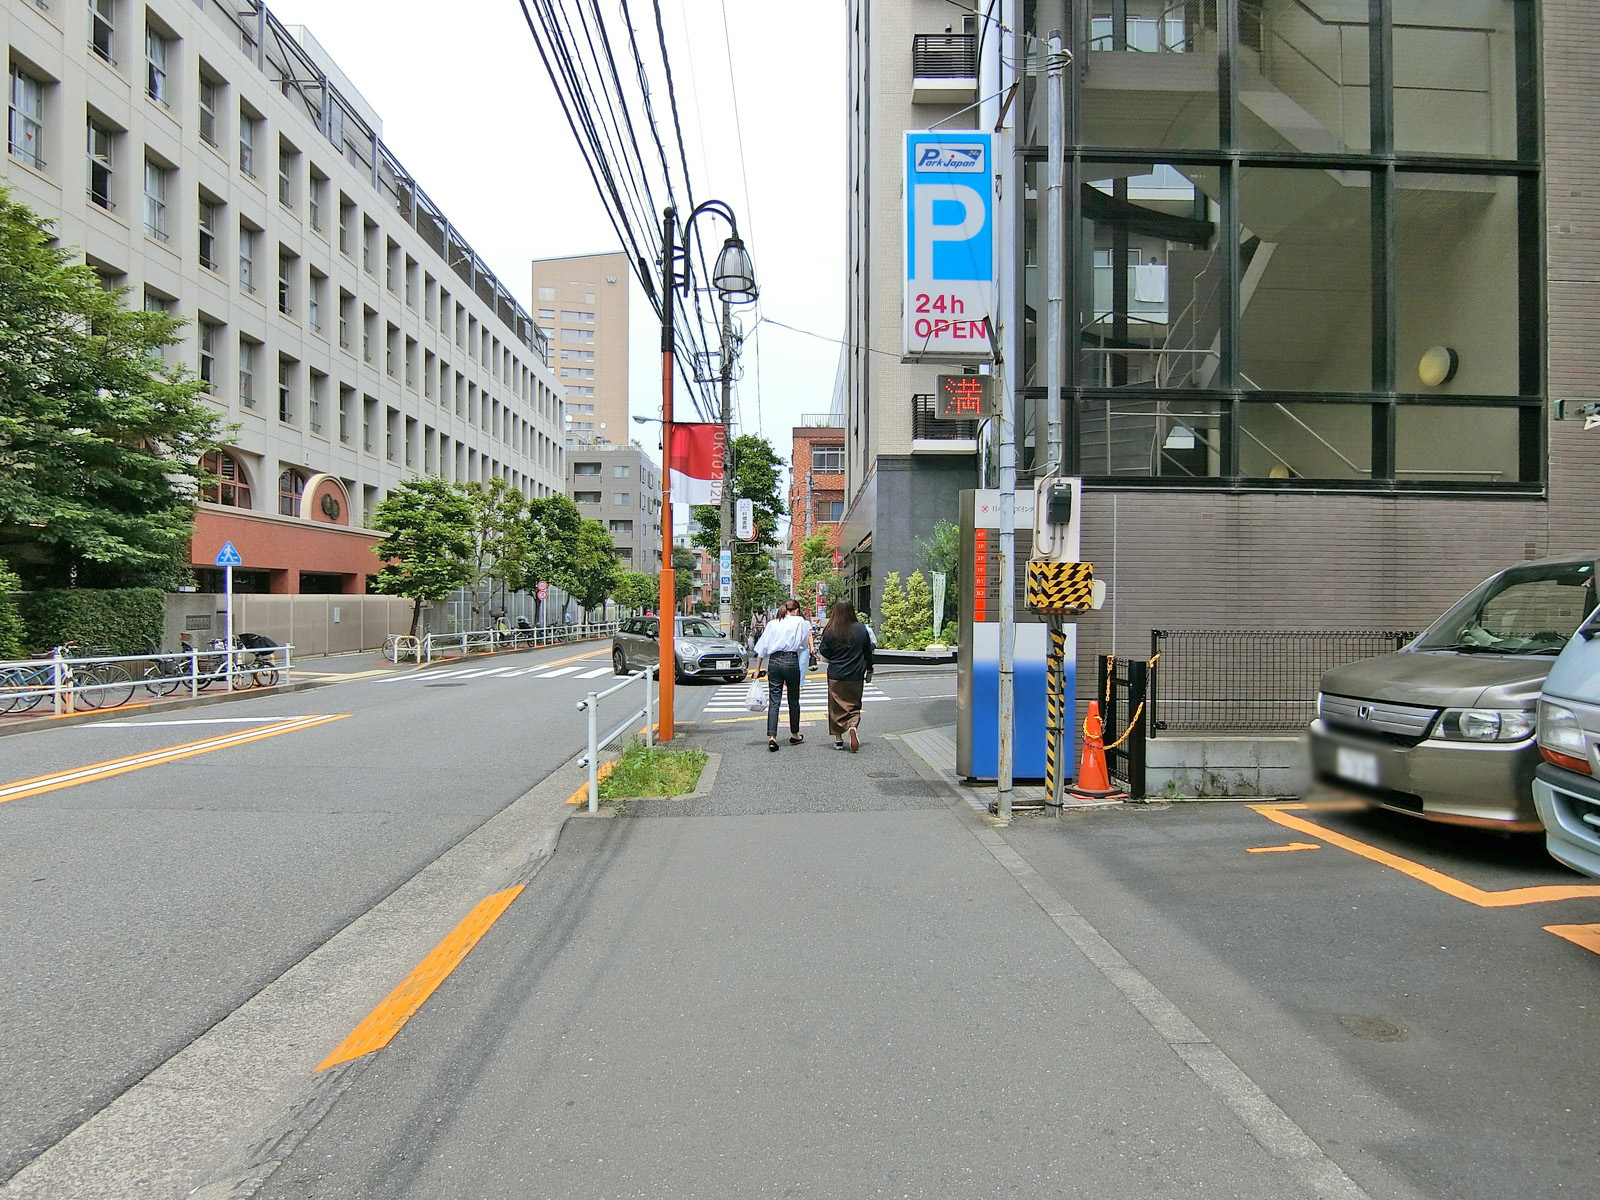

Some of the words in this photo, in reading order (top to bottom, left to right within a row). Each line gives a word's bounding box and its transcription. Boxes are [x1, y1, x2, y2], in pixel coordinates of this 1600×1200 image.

[918, 148, 944, 167] Park
[943, 157, 976, 169] Japan
[913, 183, 986, 281] P
[915, 293, 965, 314] 24h
[914, 317, 987, 339] OPEN
[944, 376, 984, 415] 満
[711, 424, 727, 469] TOKYO
[709, 471, 724, 506] 2020
